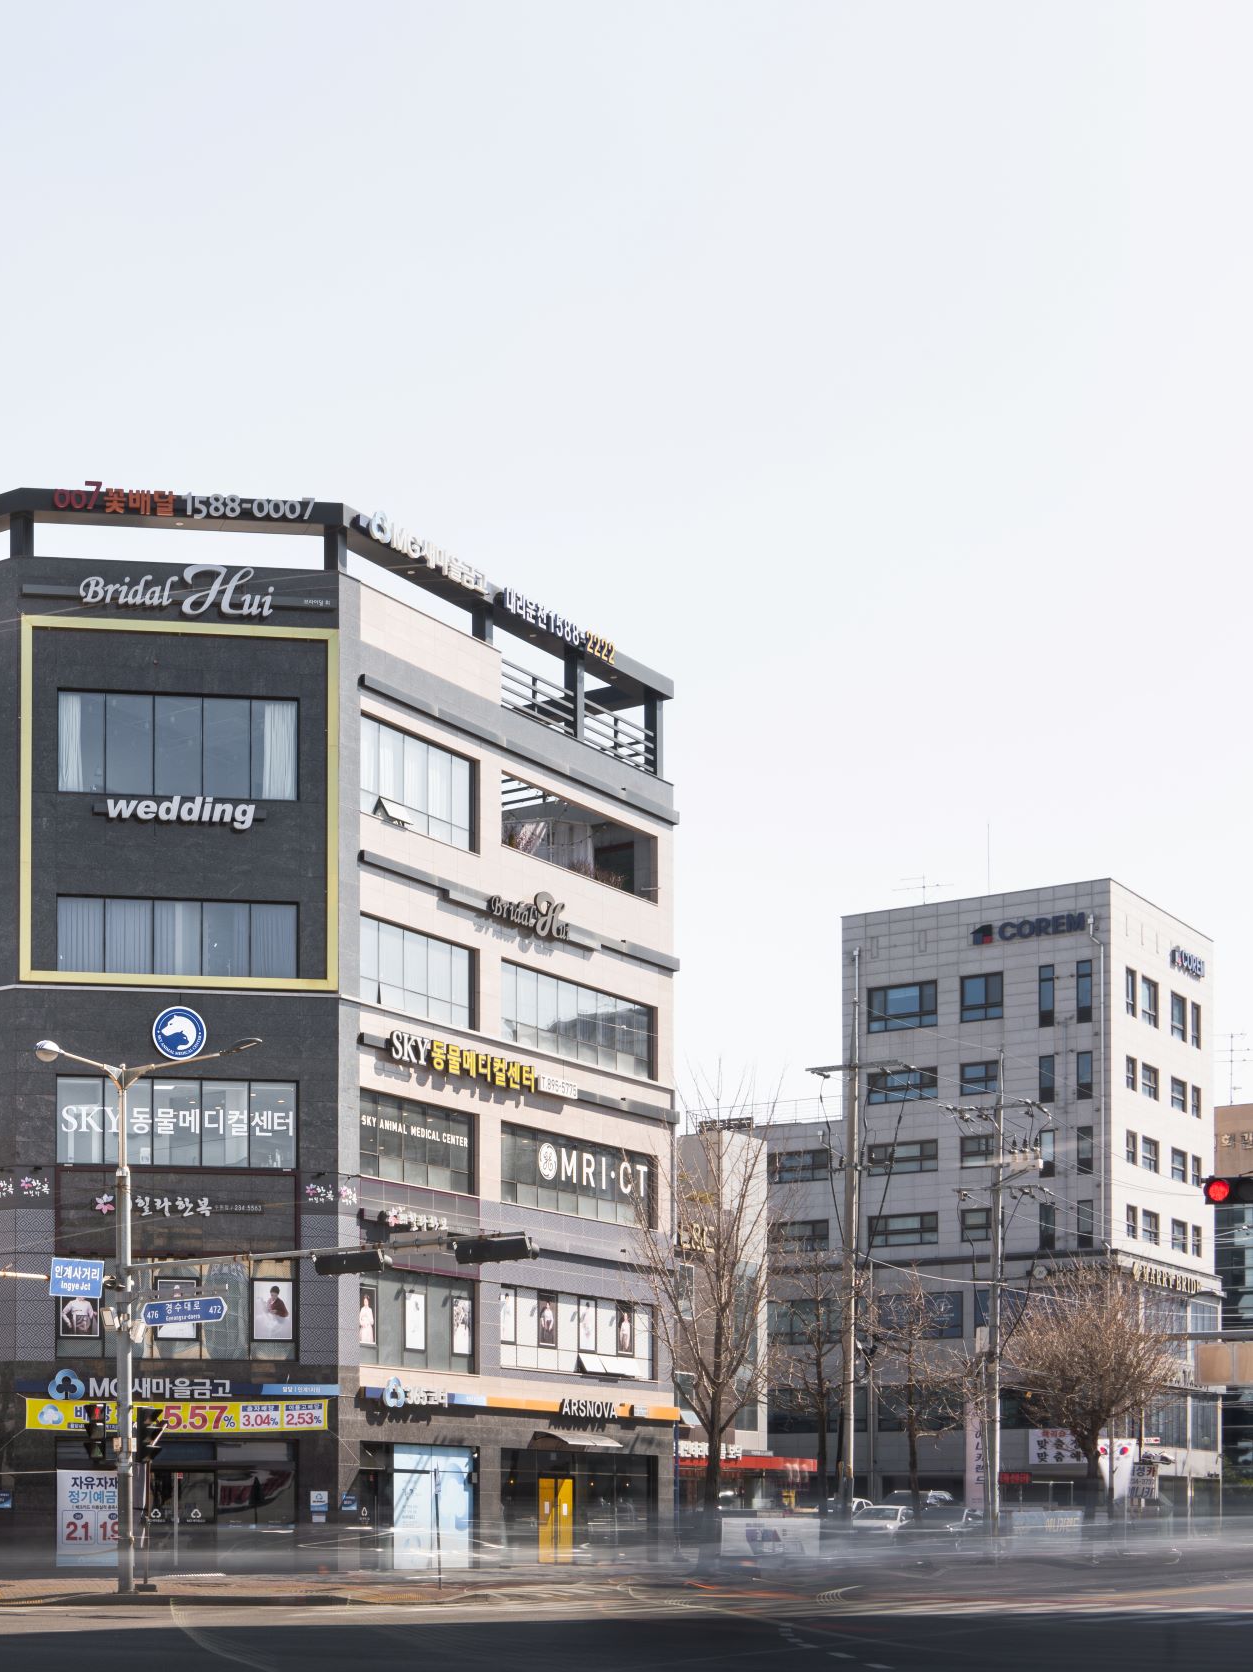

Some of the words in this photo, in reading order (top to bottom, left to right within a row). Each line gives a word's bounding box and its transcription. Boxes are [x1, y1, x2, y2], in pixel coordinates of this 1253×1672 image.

[79, 575, 179, 607] Bridal
[181, 563, 275, 618] Hui
[106, 796, 257, 830] wedding
[489, 894, 538, 927] Bridal
[998, 911, 1086, 941] COREM
[390, 1029, 430, 1066] SKY
[430, 1040, 535, 1093] 동물메디컬센터
[61, 1106, 122, 1133] SKY
[129, 1107, 295, 1137] 동물메디컬센터
[361, 1114, 377, 1127] SKY
[379, 1118, 408, 1135] ANIMAL
[410, 1126, 441, 1142] MEDICAL
[442, 1132, 469, 1148] CENTER
[54, 1265, 100, 1281] 인계사거리
[60, 1280, 80, 1291] Ingye
[80, 1281, 91, 1291] Jct
[146, 1310, 159, 1319] 476
[165, 1301, 201, 1315] 경수대로
[208, 1305, 222, 1314] 472
[242, 1413, 279, 1427] 3.04%
[286, 1412, 322, 1426] 2.53%
[562, 1398, 618, 1419] ARSNOVA
[68, 1490, 117, 1504] 정기예금
